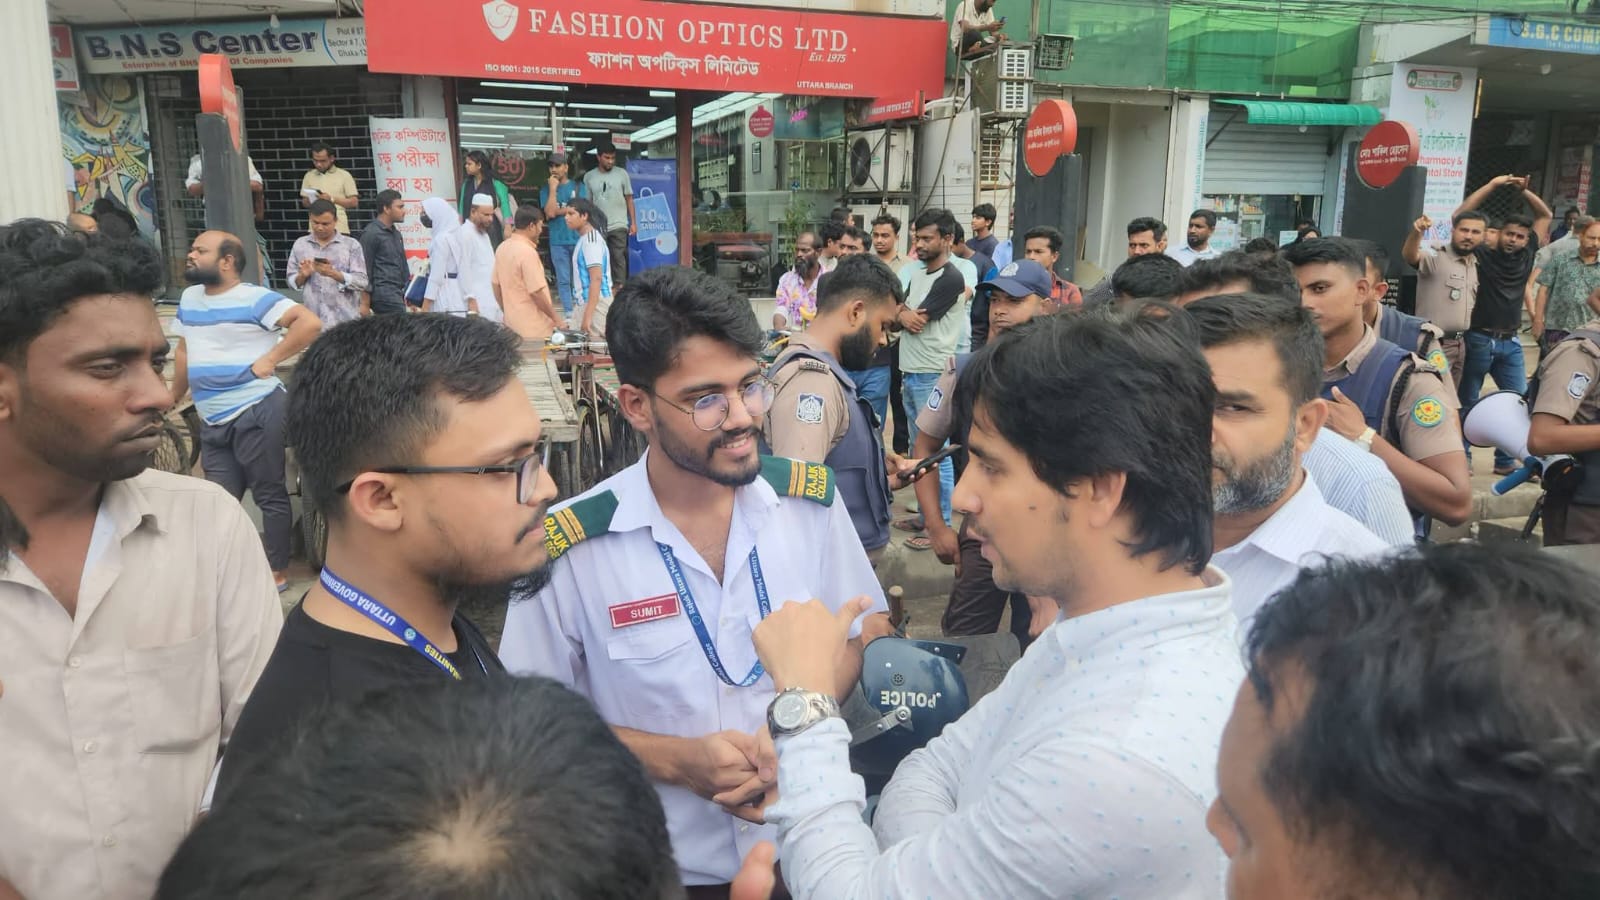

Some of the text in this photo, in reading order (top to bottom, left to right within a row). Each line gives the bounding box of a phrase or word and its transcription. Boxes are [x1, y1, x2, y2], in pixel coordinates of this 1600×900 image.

[528, 8, 857, 53] FASHION OPTICS LTD.
[85, 32, 184, 59] B.N.S
[191, 28, 318, 56] Center
[122, 60, 167, 70] Enterprise
[242, 56, 294, 66] Companies
[587, 51, 634, 71] ফ্যাশন
[704, 54, 760, 76] লিমিটেড
[808, 52, 847, 63] Est. 1975
[485, 63, 499, 71] ISO
[522, 65, 540, 74] 2015
[541, 67, 582, 77] CERTIFIED
[796, 81, 854, 90] UTTARA BRANCH
[396, 146, 440, 168] পরীক্ষা
[1419, 155, 1455, 167] harmacy
[1427, 167, 1441, 177] ntal
[385, 177, 408, 193] করা
[806, 465, 818, 496] RAJUK
[817, 464, 828, 499] COLLEGE
[544, 517, 569, 553] RAJUK
[357, 594, 396, 626] UTTARA
[631, 605, 663, 619] SUMIT
[880, 690, 936, 709] POLICE
